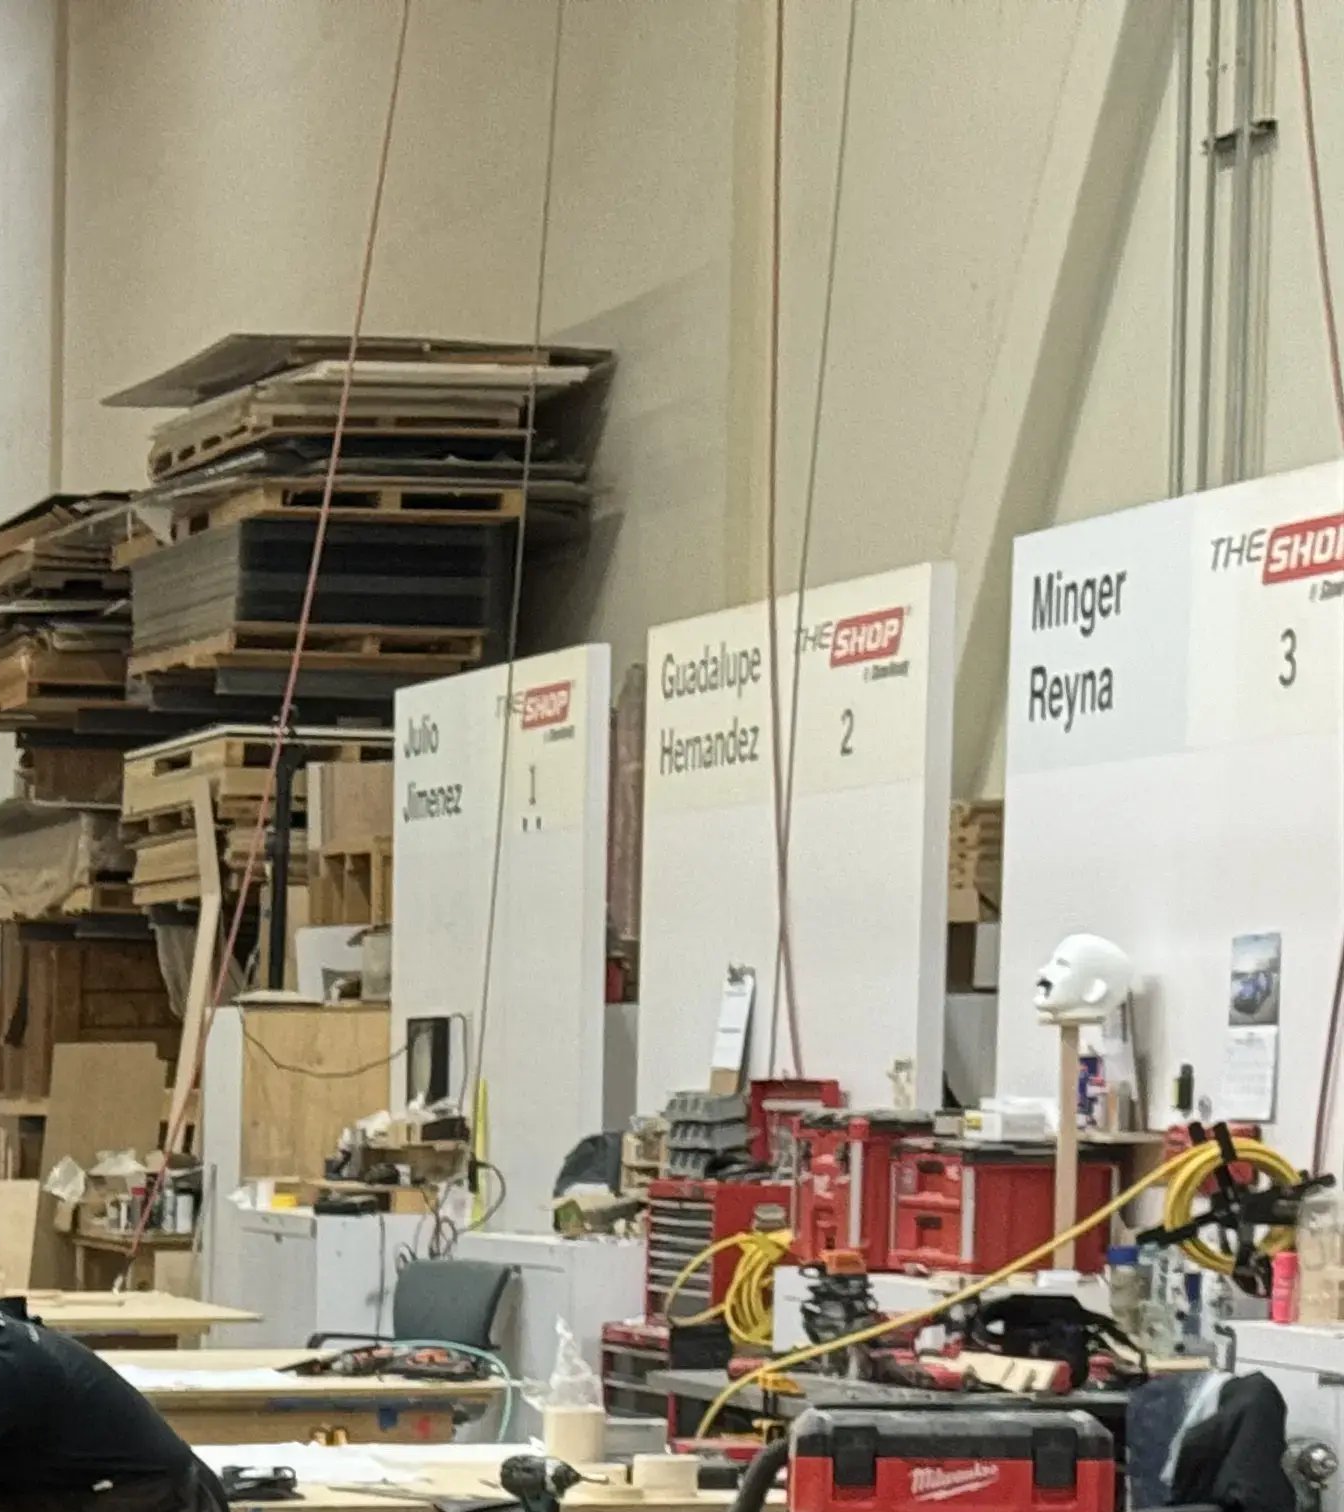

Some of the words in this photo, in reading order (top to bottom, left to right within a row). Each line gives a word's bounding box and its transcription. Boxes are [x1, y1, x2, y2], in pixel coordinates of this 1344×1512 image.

[1210, 528, 1268, 572] THE
[1031, 569, 1127, 638] Minger
[834, 617, 900, 660] SHOP
[1278, 628, 1297, 688] 3
[661, 640, 762, 701] Guadalupe
[525, 689, 569, 724] SHOP
[1028, 664, 1113, 734] Reyna
[404, 714, 439, 759] Julio
[659, 716, 760, 776] Hernandez
[840, 707, 854, 757] 2
[402, 781, 462, 823] Jimenez
[528, 764, 537, 806] 1
